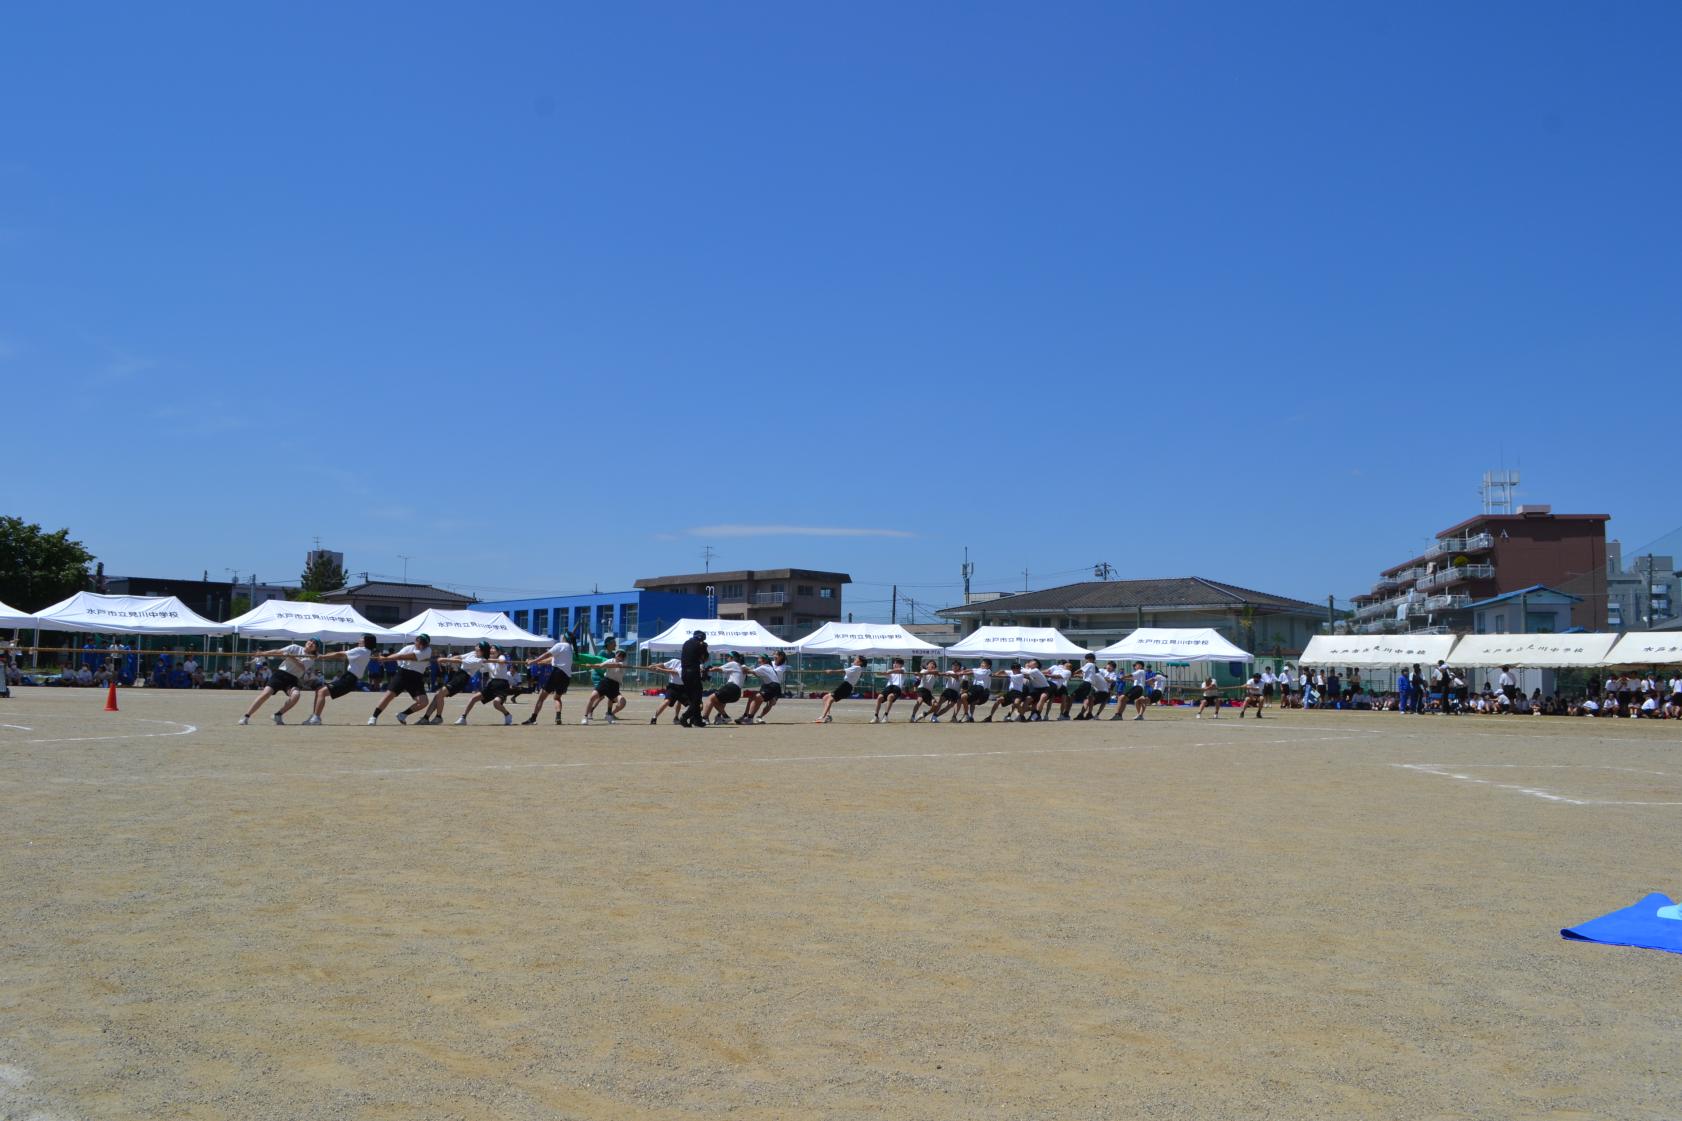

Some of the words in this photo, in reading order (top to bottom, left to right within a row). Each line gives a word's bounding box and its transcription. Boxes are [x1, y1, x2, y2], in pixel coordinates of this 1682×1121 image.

[86, 608, 178, 618] 水戸市立見川中学校
[276, 613, 354, 623] 水戸市立見川中学校
[437, 621, 507, 630] 水戸市立見川中学校
